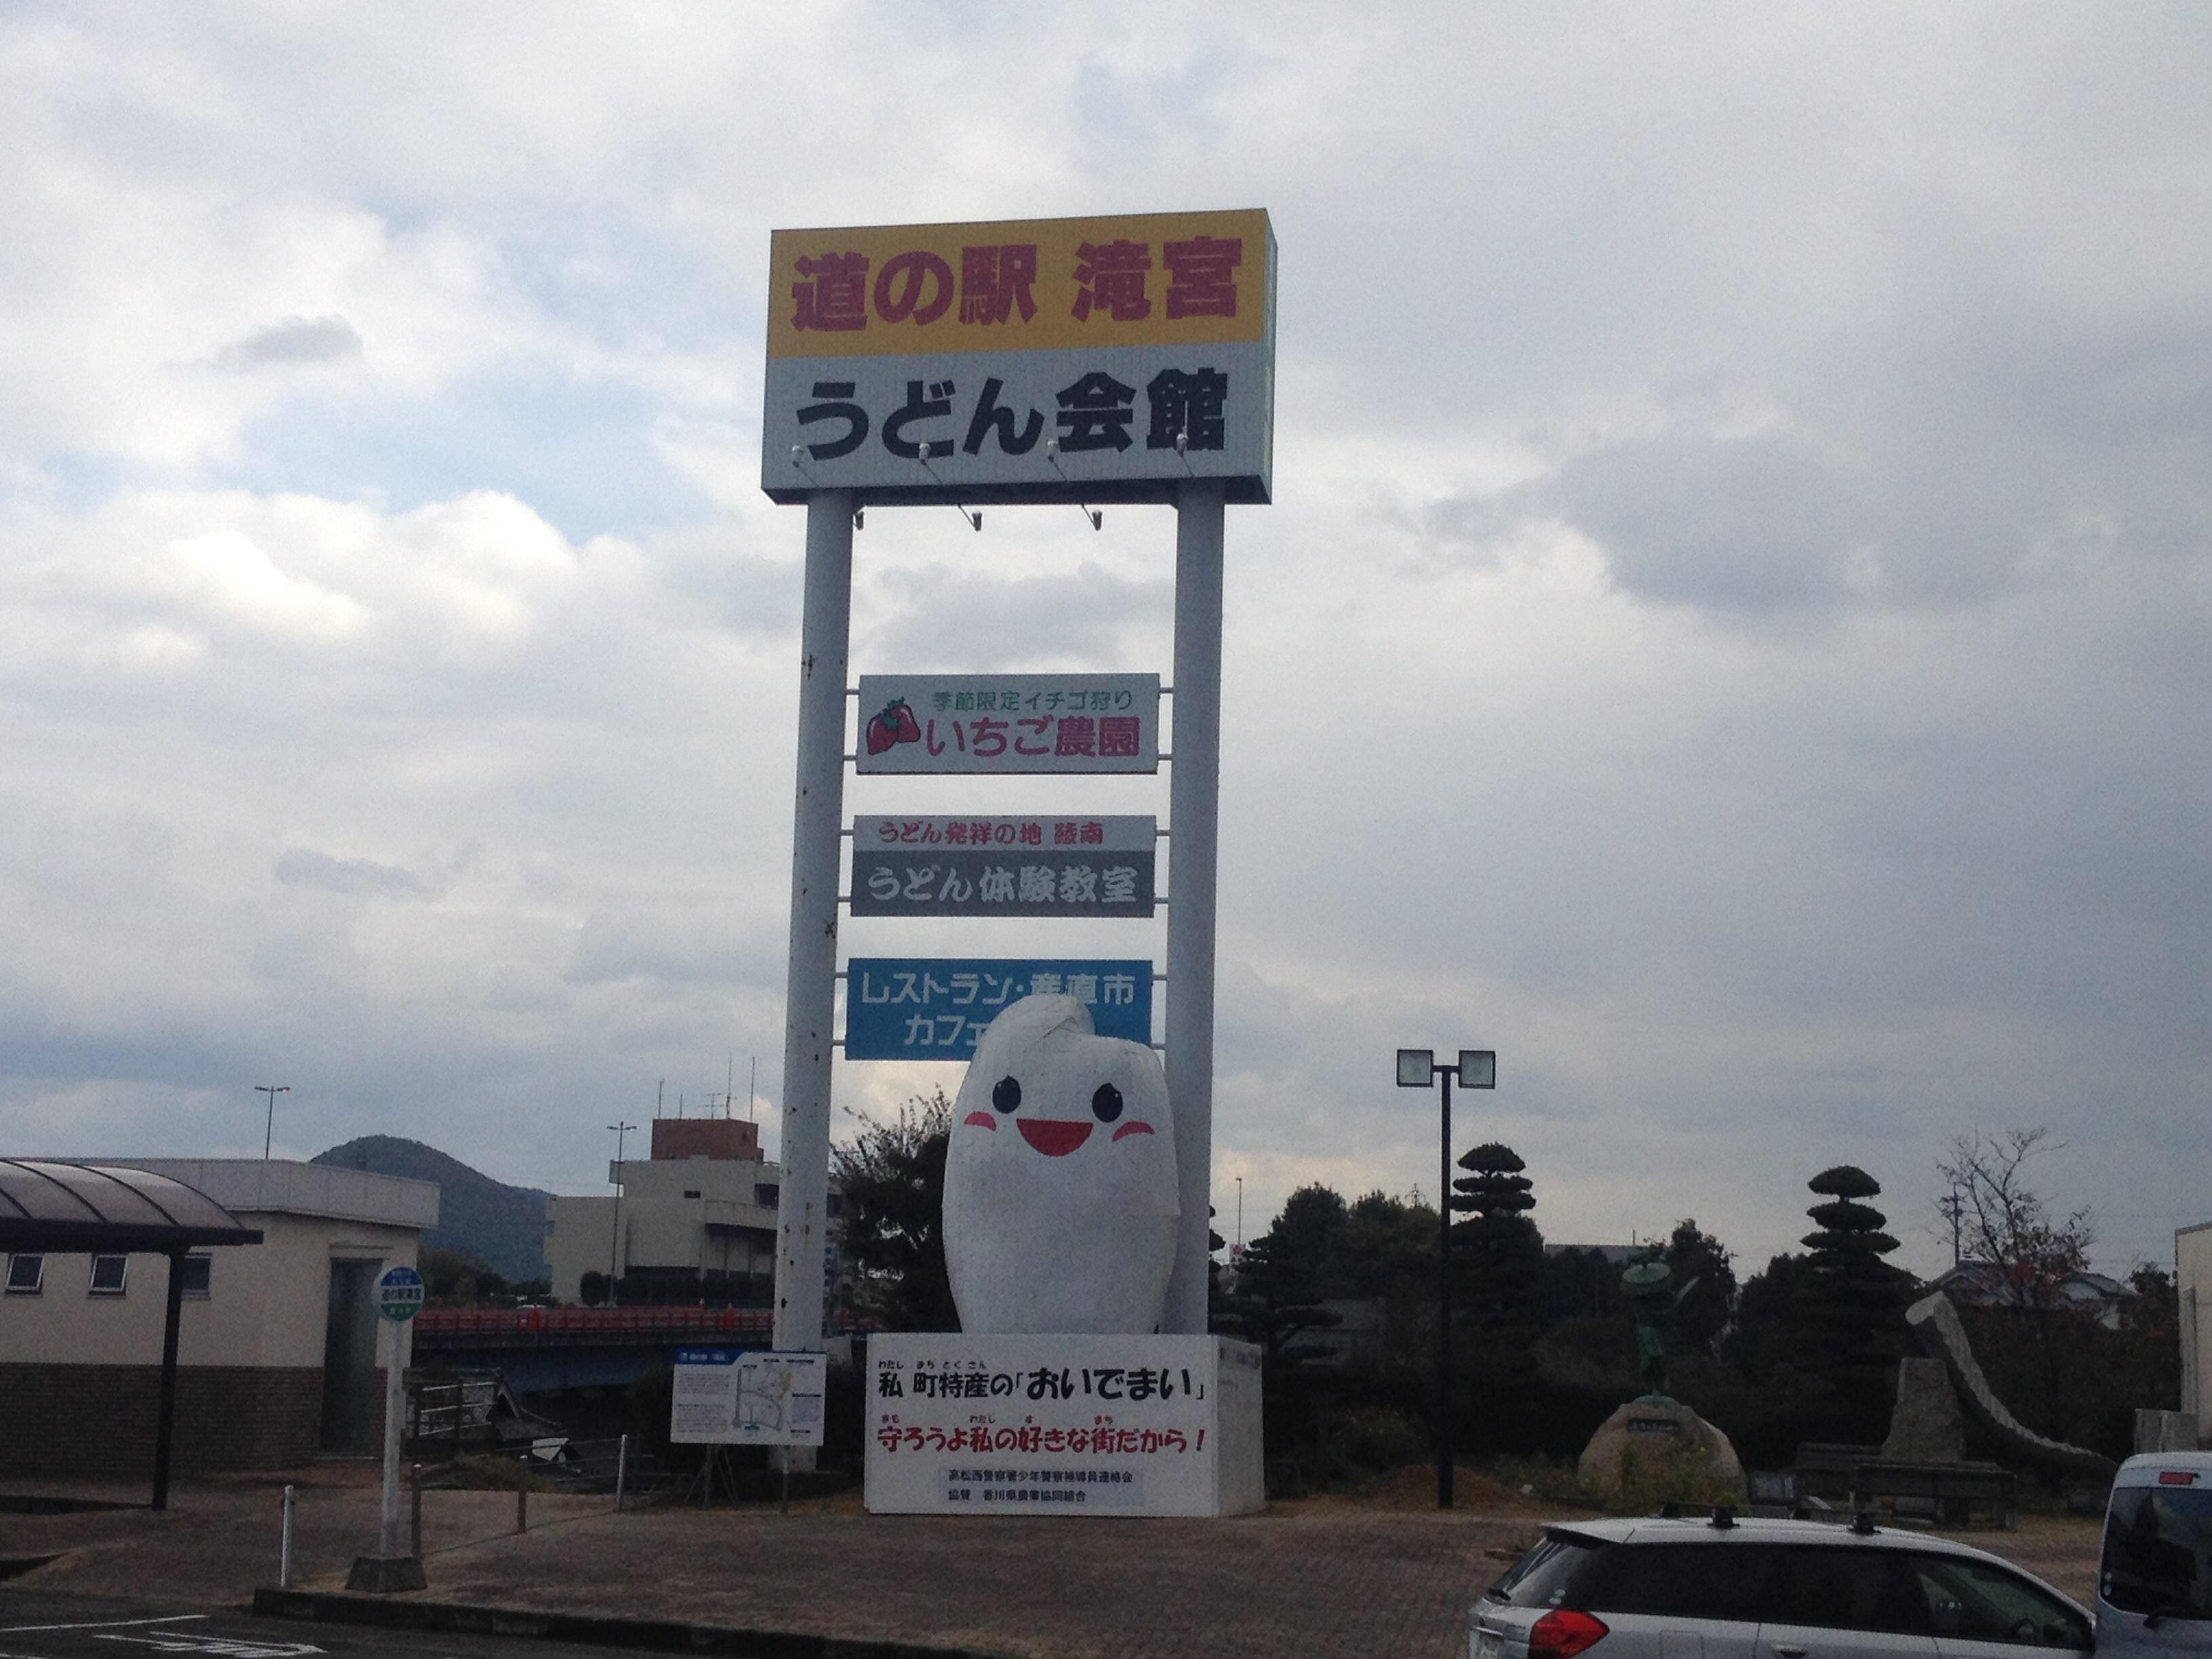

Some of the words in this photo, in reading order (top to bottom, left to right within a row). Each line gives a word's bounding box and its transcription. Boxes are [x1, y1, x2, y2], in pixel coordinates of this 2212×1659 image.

[791, 244, 1038, 331] 道の駅
[1071, 236, 1242, 321] 滝宮
[796, 367, 1228, 460] うどん会館
[933, 690, 1132, 712] 季節限定イチゴ狩り
[927, 716, 1141, 758] いちご農園
[879, 822, 1042, 845] うどん発祥の地
[869, 865, 1137, 903] うどん体験教室
